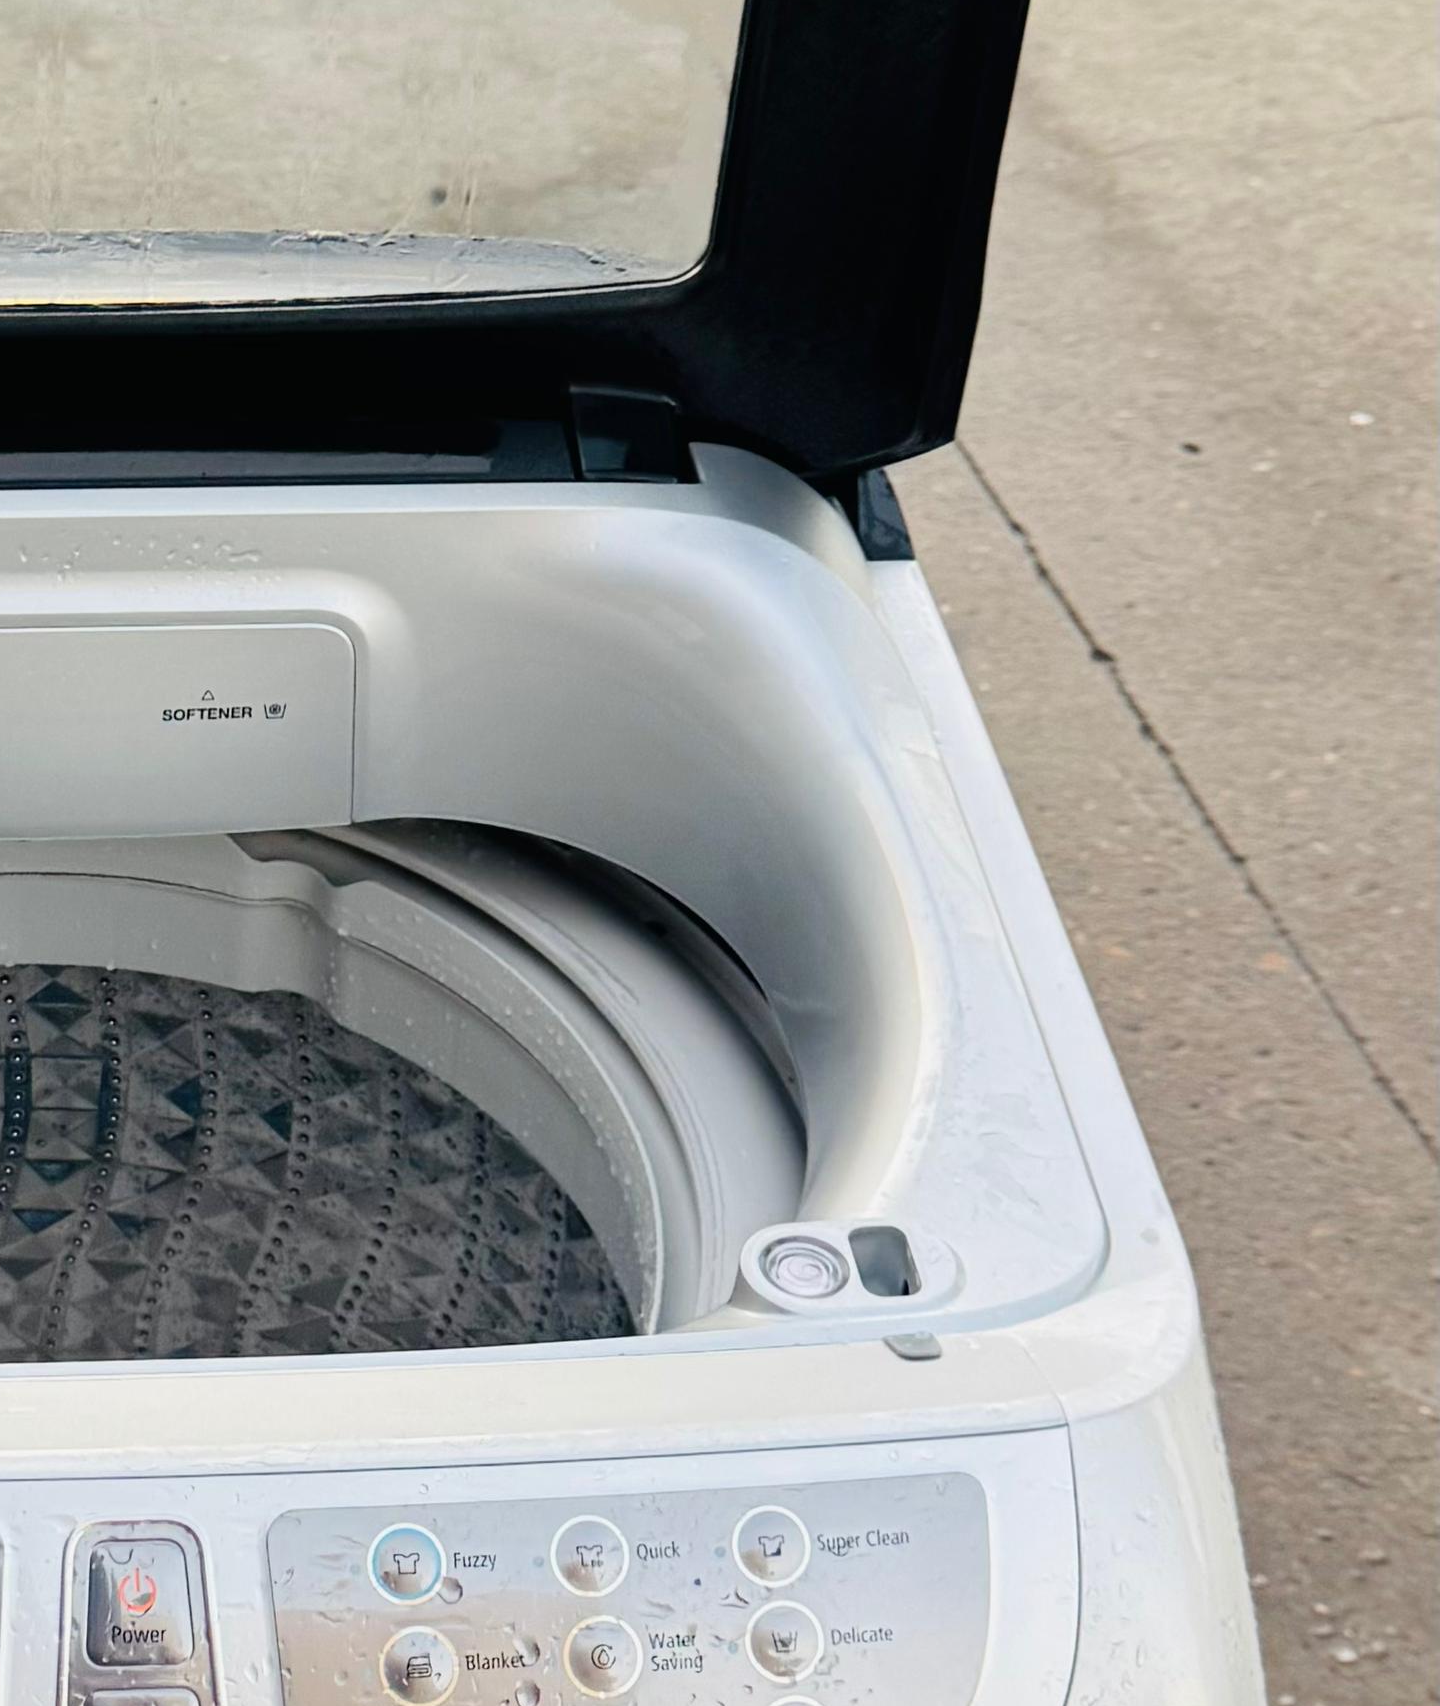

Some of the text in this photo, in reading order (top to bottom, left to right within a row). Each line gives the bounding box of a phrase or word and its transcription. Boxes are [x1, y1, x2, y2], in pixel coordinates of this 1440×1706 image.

[161, 706, 253, 722] SOFTENER
[636, 1541, 681, 1561] Quick
[816, 1529, 910, 1554] Super Clean
[453, 1552, 497, 1571] Fuzzy
[111, 1625, 167, 1644] Power
[648, 1632, 697, 1649] Water
[830, 1627, 894, 1645] Delicate
[465, 1651, 527, 1671] Blanket
[650, 1650, 704, 1673] Saving
